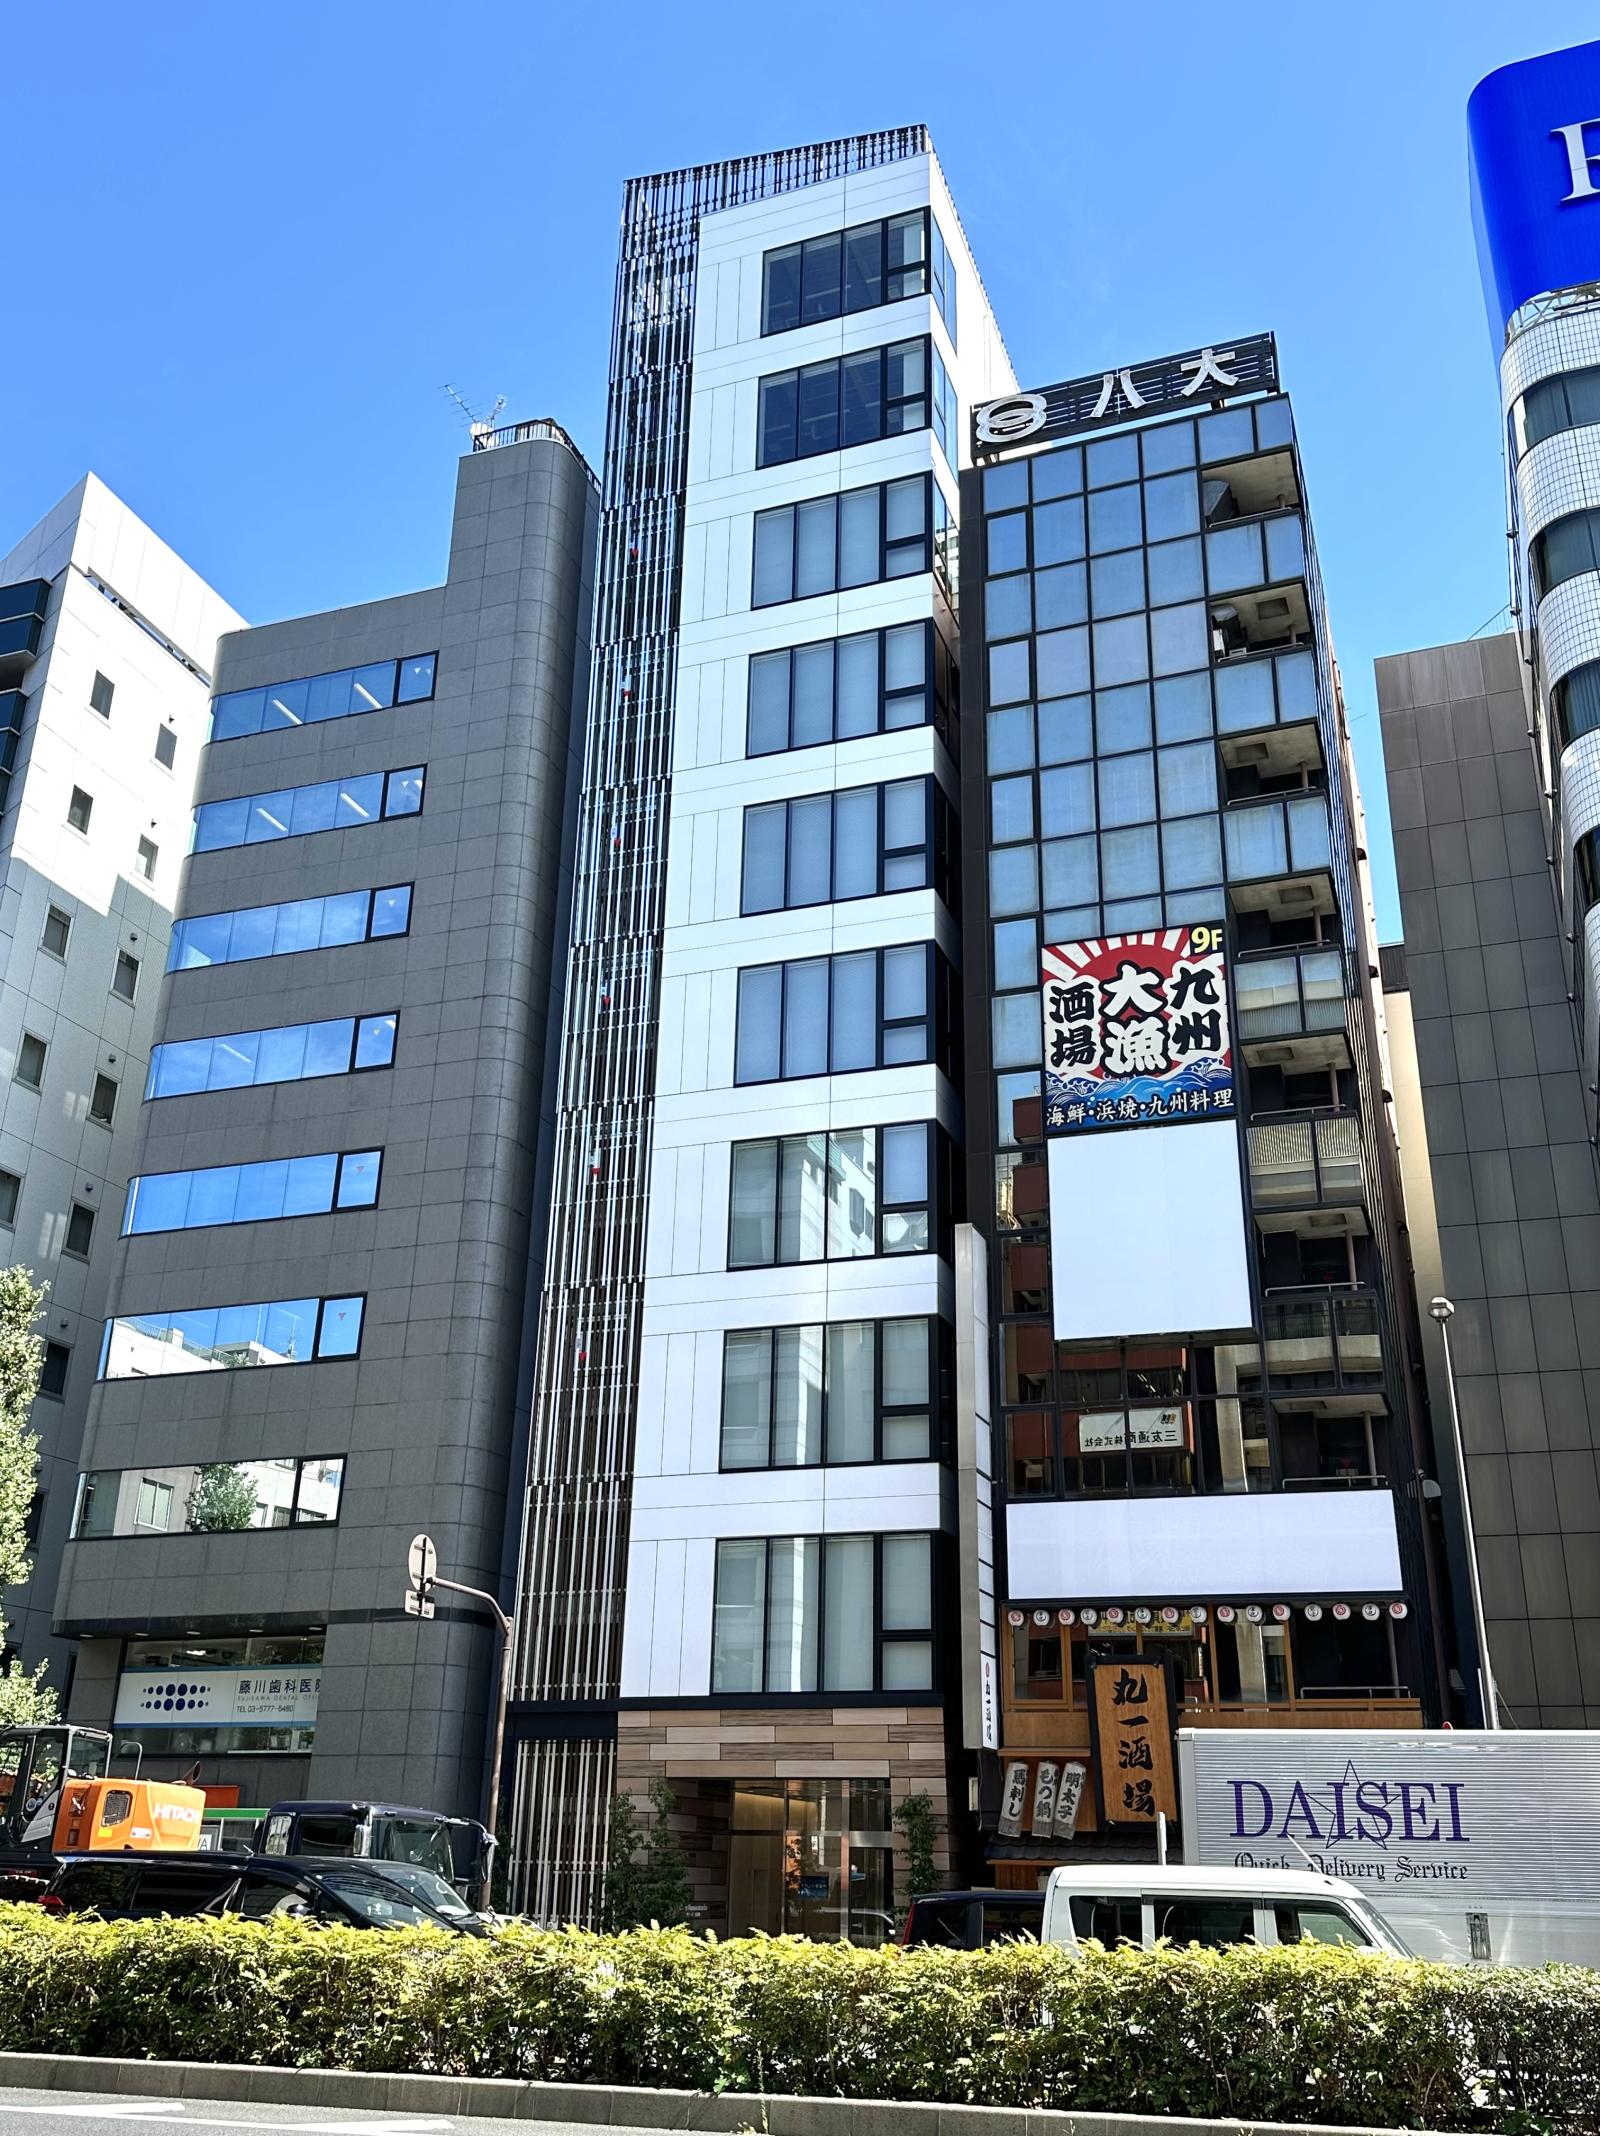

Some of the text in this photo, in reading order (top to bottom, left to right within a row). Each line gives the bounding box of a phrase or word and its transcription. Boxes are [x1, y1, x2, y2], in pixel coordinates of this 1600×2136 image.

[1191, 926, 1223, 953] 9F
[1049, 981, 1098, 1068] 酒場
[1102, 964, 1168, 1073] 大漁
[1170, 967, 1221, 1055] 九州
[236, 1705, 247, 1713] TEL
[1112, 1668, 1155, 1816] 丸一酒場
[1008, 1769, 1026, 1817] 馬刺し
[1036, 1768, 1054, 1819] もつ鍋
[1058, 1772, 1081, 1820] 明太子
[1227, 1779, 1470, 1842] DAISEI
[1395, 1855, 1469, 1883] Service
